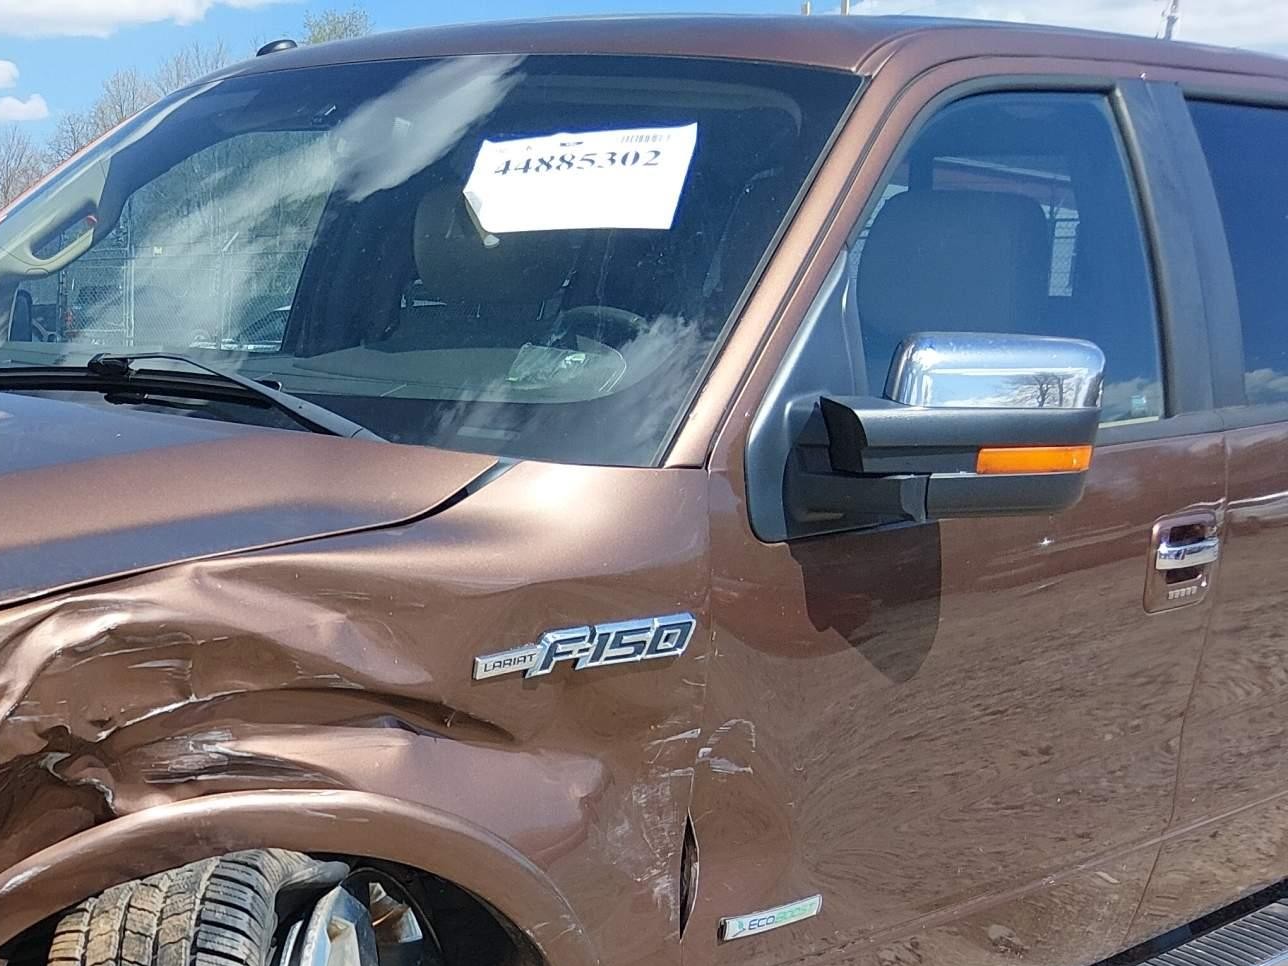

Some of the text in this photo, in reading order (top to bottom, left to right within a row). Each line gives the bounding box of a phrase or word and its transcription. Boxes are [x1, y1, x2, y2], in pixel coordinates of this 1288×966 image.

[494, 149, 662, 177] 44885302
[483, 613, 697, 679] LARIAT F-150
